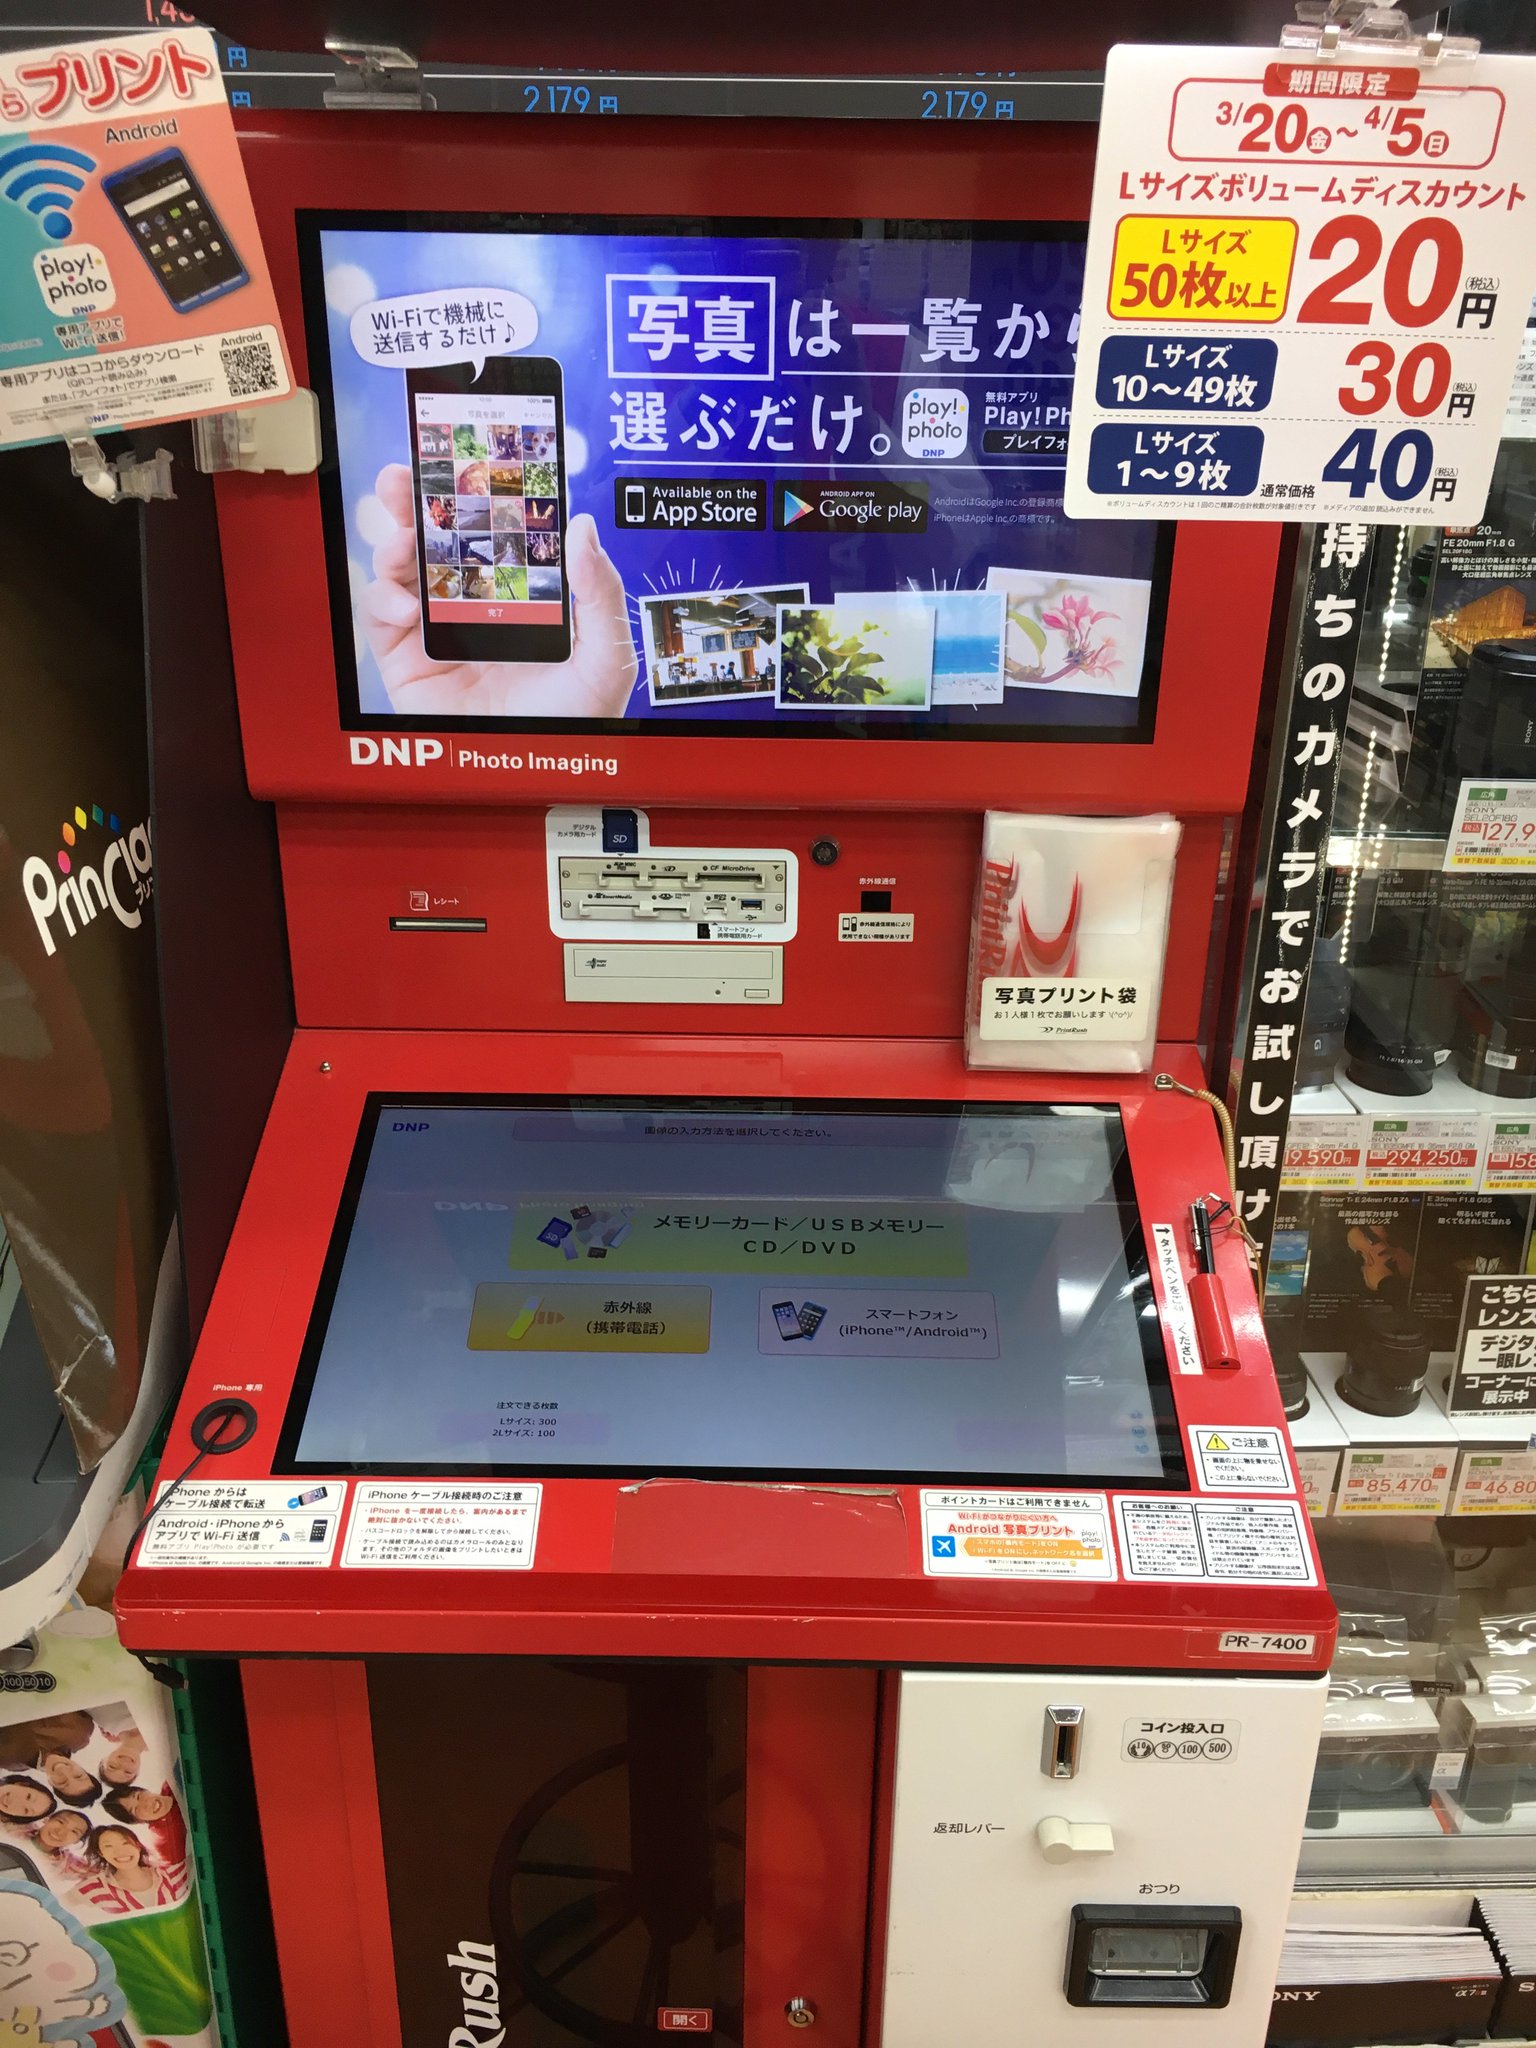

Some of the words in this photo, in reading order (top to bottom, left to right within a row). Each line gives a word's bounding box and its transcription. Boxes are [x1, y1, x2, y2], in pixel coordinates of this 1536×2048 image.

[1287, 68, 1390, 97] 期間限定
[599, 95, 618, 113] 円
[995, 100, 1014, 119] 円
[104, 119, 179, 145] Android
[1118, 171, 1527, 212] Lサイズボリュームディスカウント
[1162, 229, 1253, 255] Lサイズ
[40, 252, 97, 282] play!
[1296, 214, 1465, 329] 20
[1456, 292, 1498, 330] 円
[47, 278, 108, 306] photo
[1119, 260, 1278, 310] 50枚以上
[71, 303, 97, 316] DNP
[371, 299, 505, 332] Wi-Fiで機械に
[627, 294, 756, 364] 写真
[221, 331, 263, 348] Android
[1145, 344, 1234, 370] Lサイズ
[0, 342, 206, 389] 専用アプリはココからダウンロード
[1337, 340, 1453, 418] 30
[1446, 393, 1476, 419] 円
[985, 391, 1039, 403] 無料アプリ
[909, 397, 958, 419] play!
[608, 390, 892, 458] 選ぶだけ。
[984, 406, 1040, 430] Play!
[907, 423, 963, 442] photo
[1134, 430, 1221, 456] Lサイズ
[922, 448, 945, 457] DNP
[1321, 428, 1435, 502] 40
[1429, 478, 1458, 502] 円
[652, 485, 712, 500] Available
[717, 489, 732, 500] on
[736, 487, 758, 500] the
[820, 490, 848, 498] ANDROID
[849, 490, 863, 498] APP
[865, 490, 875, 498] ON
[1260, 484, 1316, 499] 通常価格
[652, 501, 700, 527] App
[701, 502, 758, 523] Store
[887, 502, 922, 523] play
[1443, 539, 1456, 547] FE
[1457, 539, 1484, 547] 20mm
[1486, 539, 1505, 547] F1.8
[1508, 539, 1516, 547] G
[487, 608, 504, 618] 完了
[349, 737, 444, 767] DNP
[458, 749, 523, 769] Photo
[528, 752, 618, 775] Imaging
[1464, 806, 1497, 814] SONY
[612, 834, 628, 844] SD
[859, 877, 897, 885] 赤外線通信
[433, 897, 460, 906] レシート
[994, 986, 1138, 1005] 写真プリント袋
[1313, 1039, 1322, 1050] G
[392, 1122, 430, 1132] DNP
[1343, 1156, 1352, 1165] 円
[1387, 1150, 1461, 1166] 294,250
[1460, 1157, 1468, 1165] 円
[602, 1300, 653, 1315] 赤外線
[865, 1308, 960, 1321] スマートフォン
[585, 1321, 667, 1335] (携帯電話)
[245, 1384, 263, 1392] 専用
[1482, 1389, 1530, 1405] 展示中
[496, 1401, 559, 1410] 注文できる枚数
[538, 1417, 557, 1426] 300
[537, 1428, 556, 1437] 100
[1231, 1437, 1270, 1449] ご注意
[213, 1487, 247, 1497] からは
[1366, 1478, 1433, 1493] 85,470
[367, 1490, 408, 1500] iPhone
[410, 1490, 523, 1502] ケーブル接続時のご注意
[940, 1495, 1090, 1508] ポイントカードはご利用できません
[163, 1498, 266, 1510] ケーブル接続で転送
[369, 1507, 400, 1515] iPhone
[262, 1518, 285, 1529] から
[947, 1523, 999, 1535] Android
[1003, 1524, 1074, 1537] 写真プリント
[154, 1530, 199, 1542] アプリで
[203, 1530, 234, 1541] Wi-Fi
[235, 1530, 260, 1542] 送信
[1224, 1634, 1308, 1651] PR-7400
[5, 1677, 21, 1687] 100
[24, 1677, 36, 1687] 50
[40, 1677, 51, 1687] 10
[1140, 1722, 1225, 1734] コイン投入口
[1182, 1744, 1198, 1754] 100
[1208, 1742, 1227, 1753] 500
[932, 1822, 1006, 1835] 返却レバー
[1138, 1882, 1181, 1895] おつり
[446, 1939, 508, 2048] Rush
